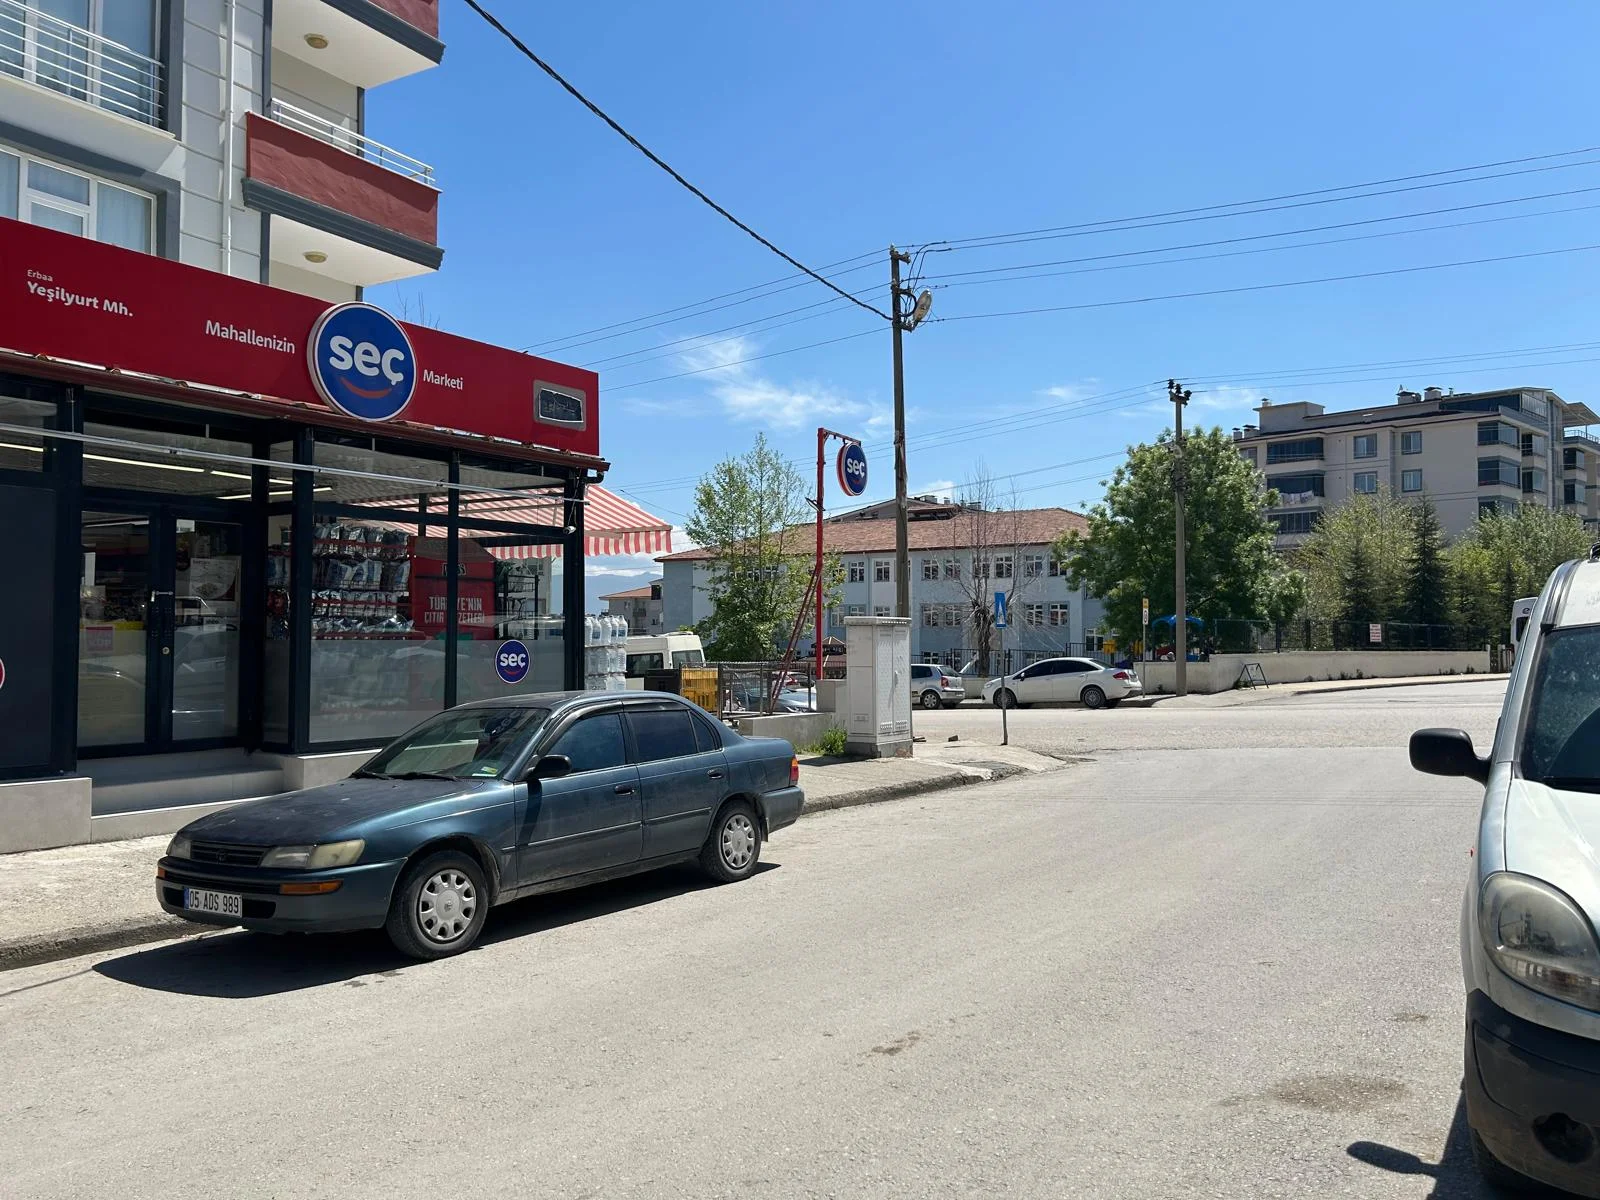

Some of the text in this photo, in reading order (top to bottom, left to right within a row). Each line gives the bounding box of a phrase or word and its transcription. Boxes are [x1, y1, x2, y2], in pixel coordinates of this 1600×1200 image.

[27, 269, 53, 282] Erbaa
[27, 281, 134, 317] Yeşilyurt Mh.
[205, 319, 464, 391] Mahallenizin seç Marketi
[847, 458, 865, 478] seç
[500, 653, 526, 668] seç
[189, 890, 239, 914] 05 ADS 989
